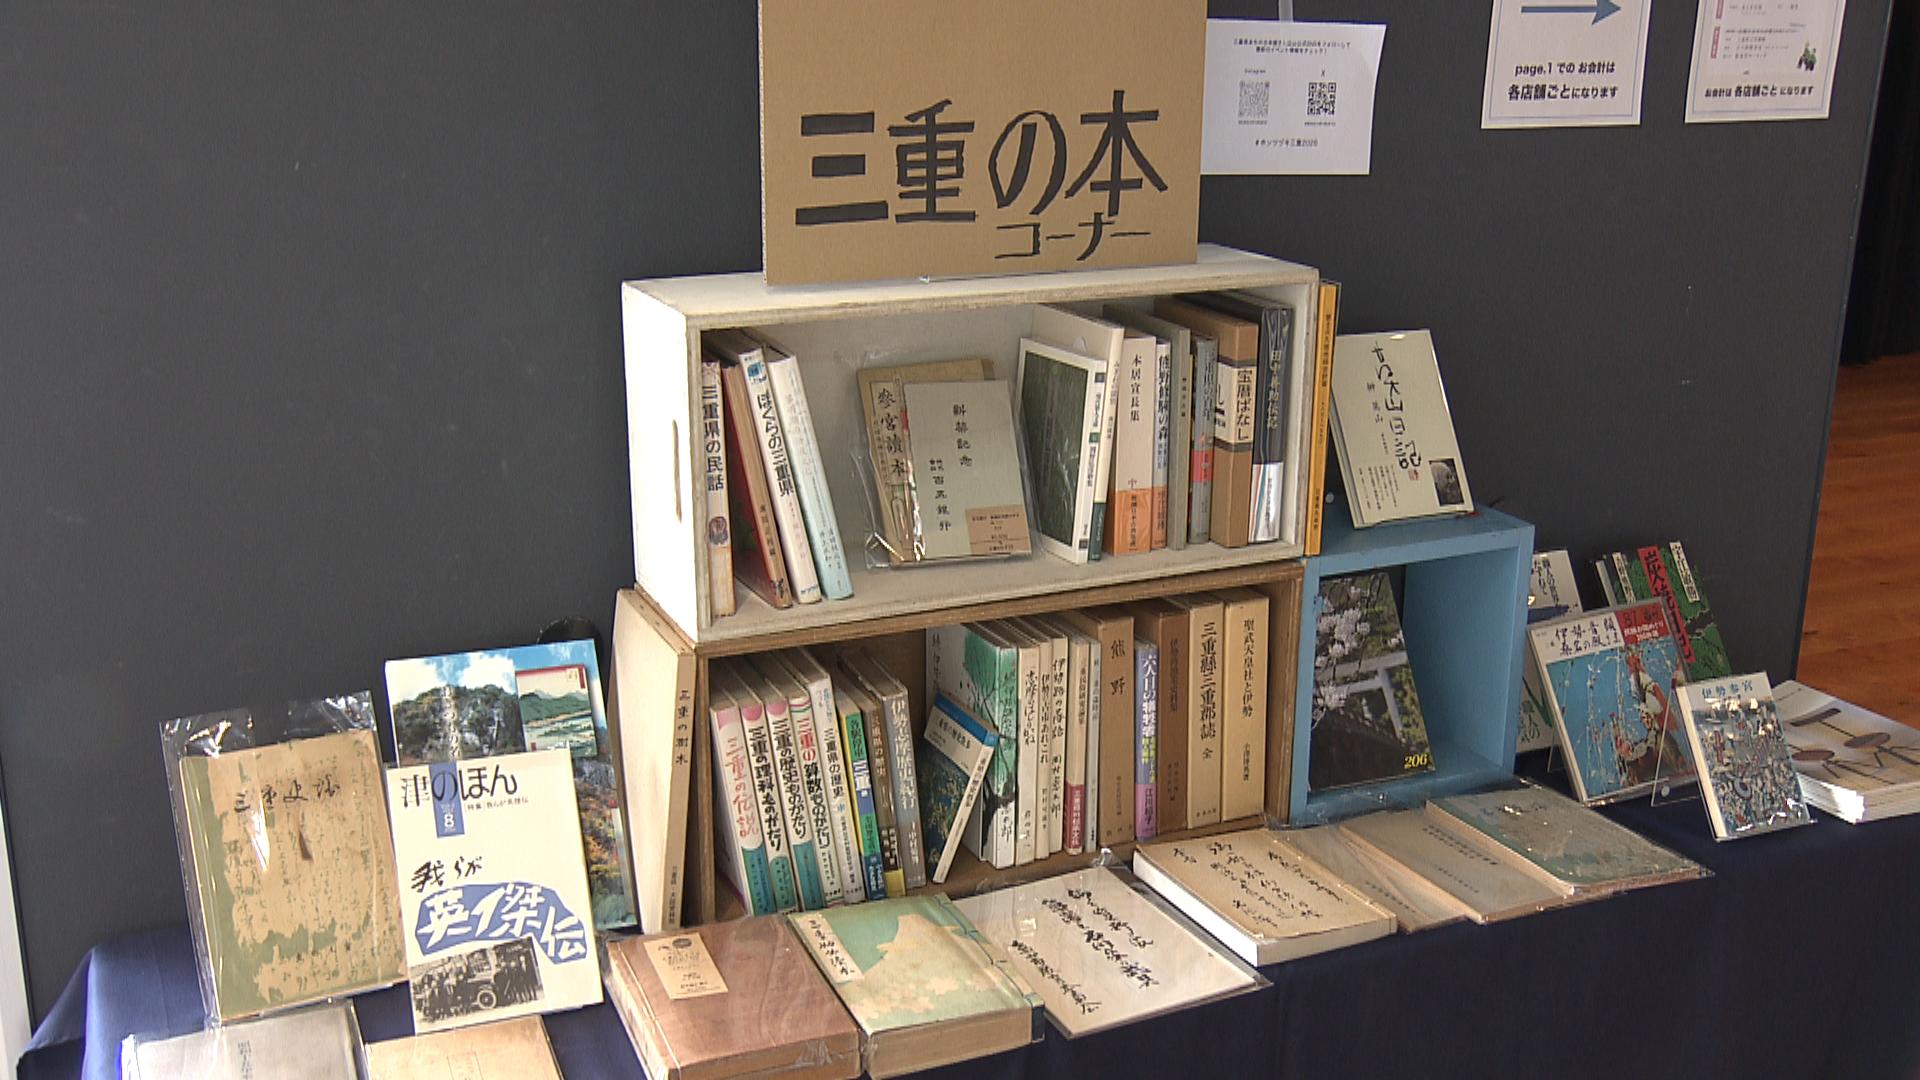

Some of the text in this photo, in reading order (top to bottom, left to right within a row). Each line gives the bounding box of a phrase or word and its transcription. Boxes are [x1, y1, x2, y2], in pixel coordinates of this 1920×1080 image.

[1508, 84, 1618, 100] 各店舗ごとになります
[1557, 62, 1575, 73] での
[1578, 61, 1615, 74] お会計は
[1705, 84, 1814, 97] お会計は 各店舗ごと になります
[795, 90, 1168, 225] 三重の本
[994, 212, 1151, 261] コーナー
[1130, 354, 1142, 422] 本居宣長集
[1157, 356, 1171, 440] 熊野修験の森
[1236, 369, 1252, 441] 宝暦ばなし
[702, 385, 724, 491] 三重県の民話
[757, 391, 793, 496] ぼくらの三重県
[1110, 639, 1126, 696] 熊野
[401, 764, 518, 808] 津のほん
[725, 736, 760, 839] 三重の伝説
[749, 725, 783, 852] 三重の理科ものがたり
[772, 718, 808, 840] 三重の歴史ものがたり
[796, 718, 831, 850] 三重の算数ものがたり
[823, 727, 845, 799] 三重県の歴史
[1404, 753, 1428, 769] 206
[444, 813, 455, 828] 8
[411, 855, 483, 893] 我らが
[416, 882, 586, 961] 英傑伝
